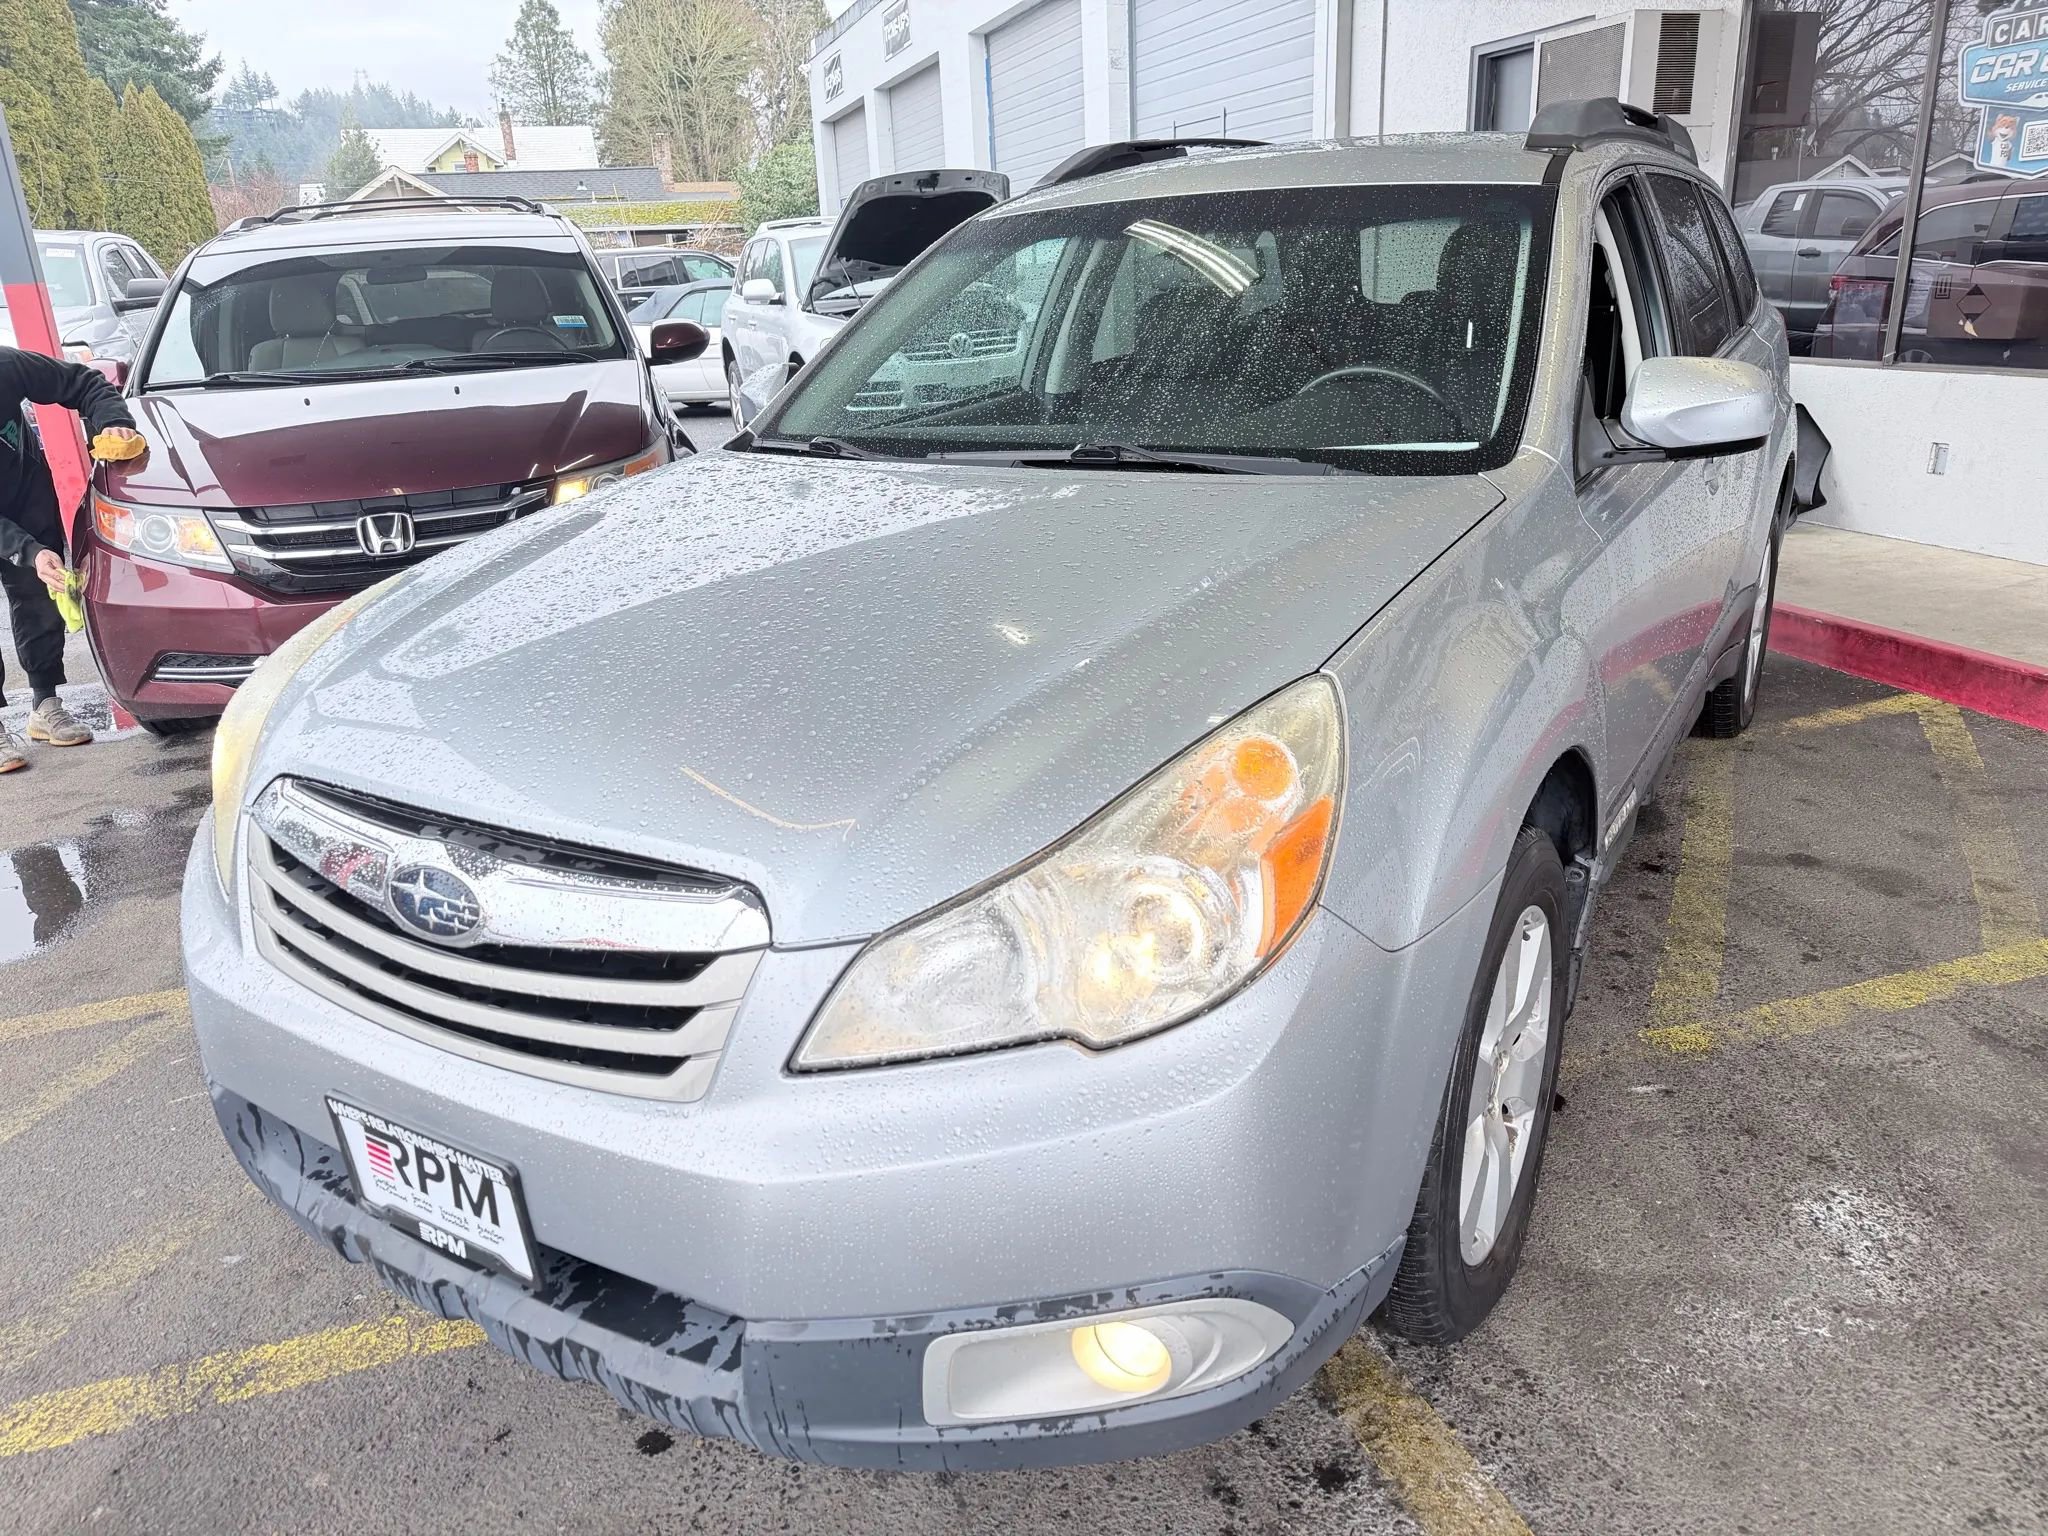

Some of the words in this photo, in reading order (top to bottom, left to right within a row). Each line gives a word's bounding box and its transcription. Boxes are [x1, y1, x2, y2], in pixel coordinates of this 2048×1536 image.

[1970, 49, 2040, 84] CAR
[2004, 78, 2048, 94] SERVICE
[364, 1126, 500, 1228] RPM
[455, 1150, 507, 1186] MATTER
[418, 1221, 467, 1259] RPM
